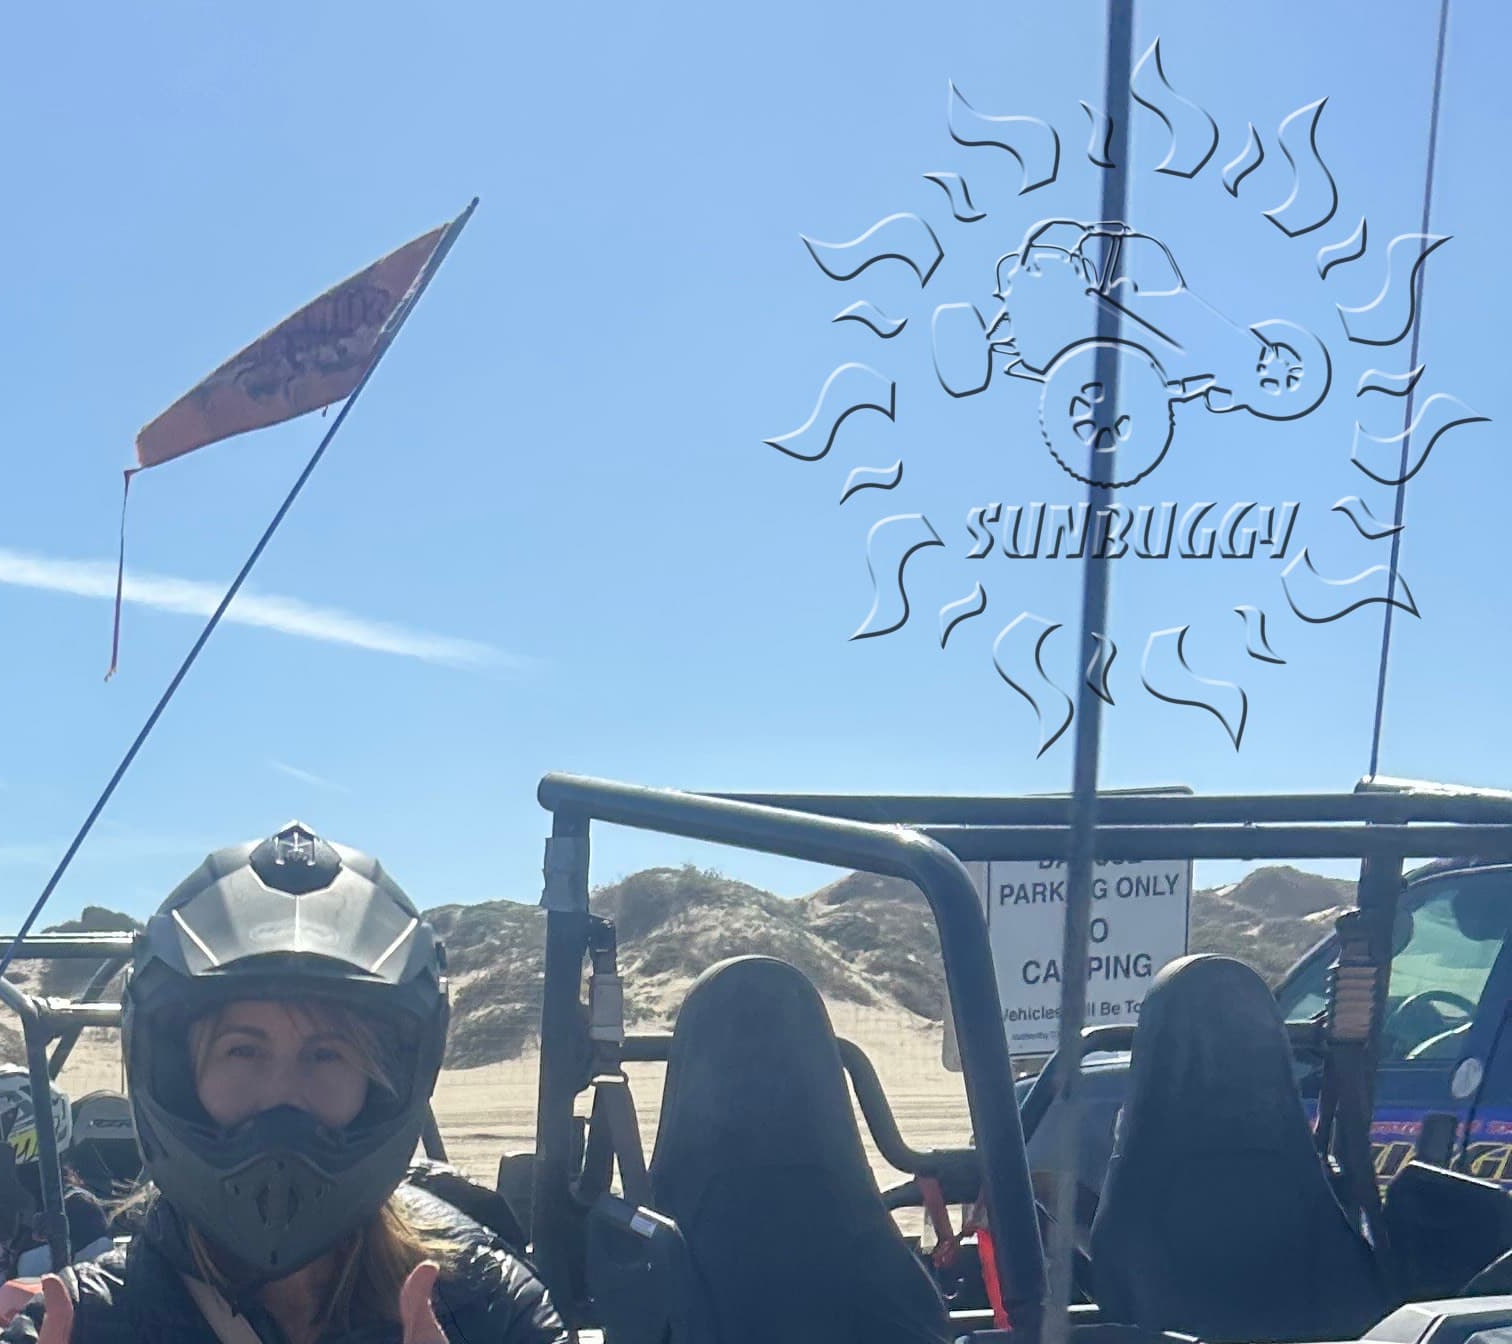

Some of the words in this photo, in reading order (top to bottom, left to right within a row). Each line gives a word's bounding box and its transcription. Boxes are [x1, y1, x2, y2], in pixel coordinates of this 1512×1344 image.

[1000, 878, 1108, 905] PARKG
[1116, 874, 1179, 898] ONLY
[1022, 953, 1152, 985] CAPING
[1100, 1001, 1121, 1016] Be
